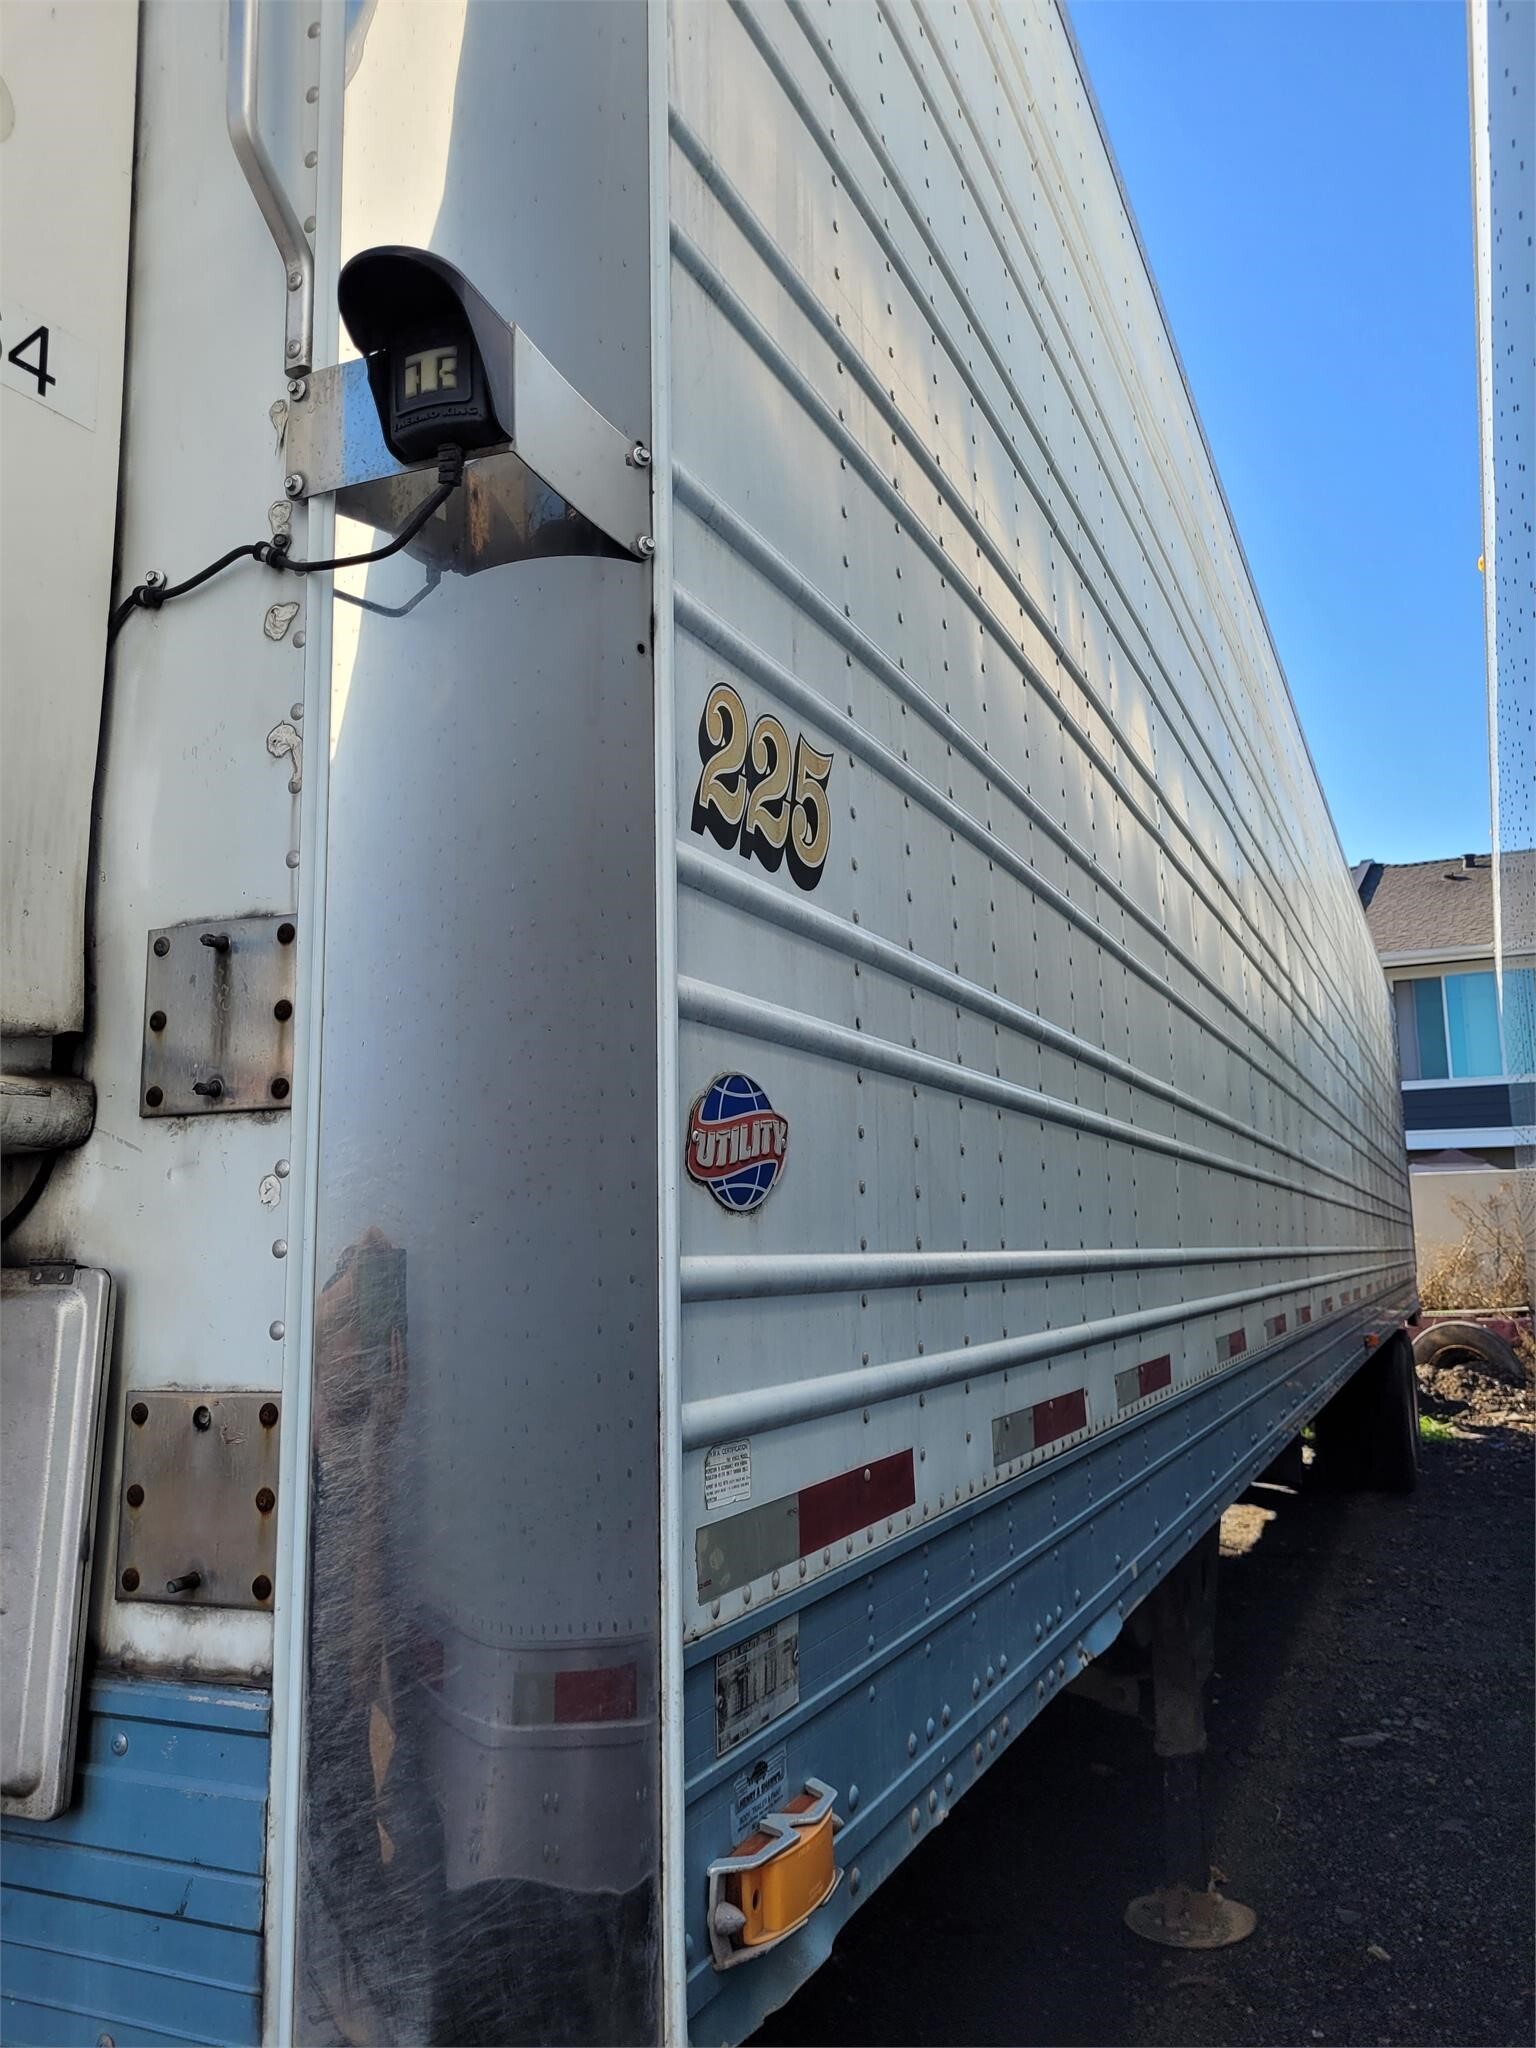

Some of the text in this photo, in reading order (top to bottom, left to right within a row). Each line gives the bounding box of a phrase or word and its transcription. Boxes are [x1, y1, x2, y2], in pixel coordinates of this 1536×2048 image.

[442, 407, 479, 418] KING
[691, 682, 834, 891] 225
[696, 1119, 787, 1168] UTILITY
